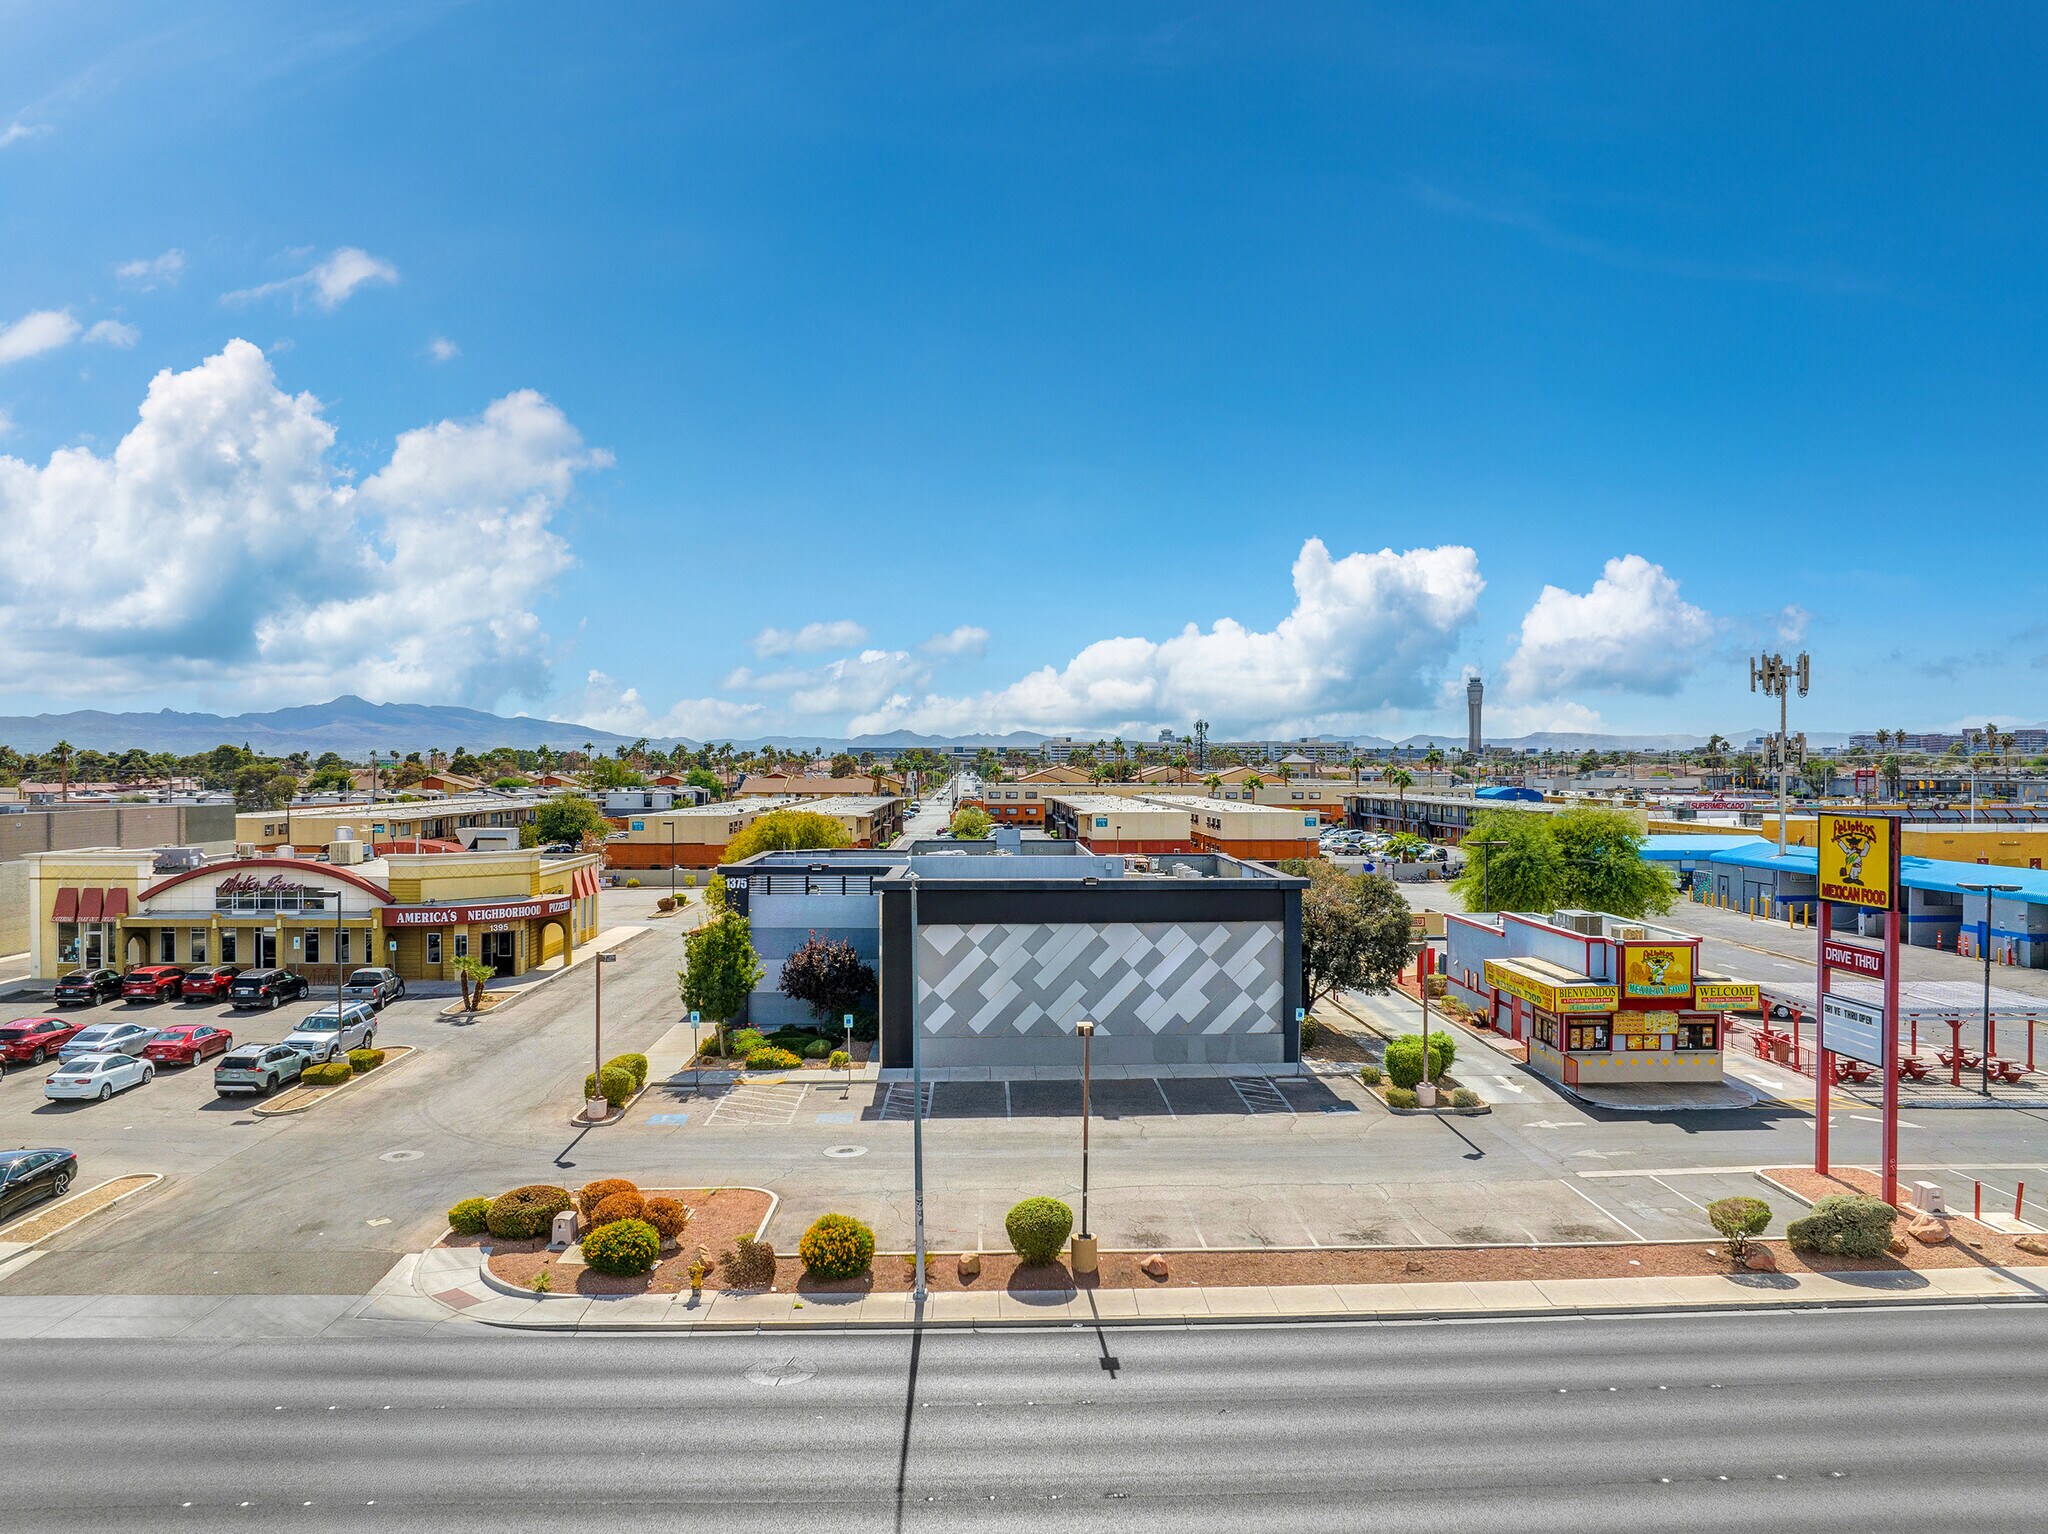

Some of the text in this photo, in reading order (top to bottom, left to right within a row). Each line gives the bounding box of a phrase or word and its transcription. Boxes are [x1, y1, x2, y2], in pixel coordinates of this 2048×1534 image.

[262, 874, 306, 895] Pizza
[725, 878, 748, 889] 1375
[1822, 883, 1887, 905] MEXICAN FOOD
[397, 900, 571, 924] AMERICA'S NEIGHBORHOOD PIZZERIA
[489, 923, 509, 932] 1395
[1825, 947, 1879, 971] DRIVE THRU
[1524, 989, 1542, 1004] FOOD
[1559, 987, 1616, 998] BIENVENIDOS
[1627, 982, 1690, 996] MEXICAN FOOD
[1699, 986, 1756, 997] WELCOME
[1844, 1009, 1858, 1022] THRU
[1859, 1013, 1873, 1025] OPEN
